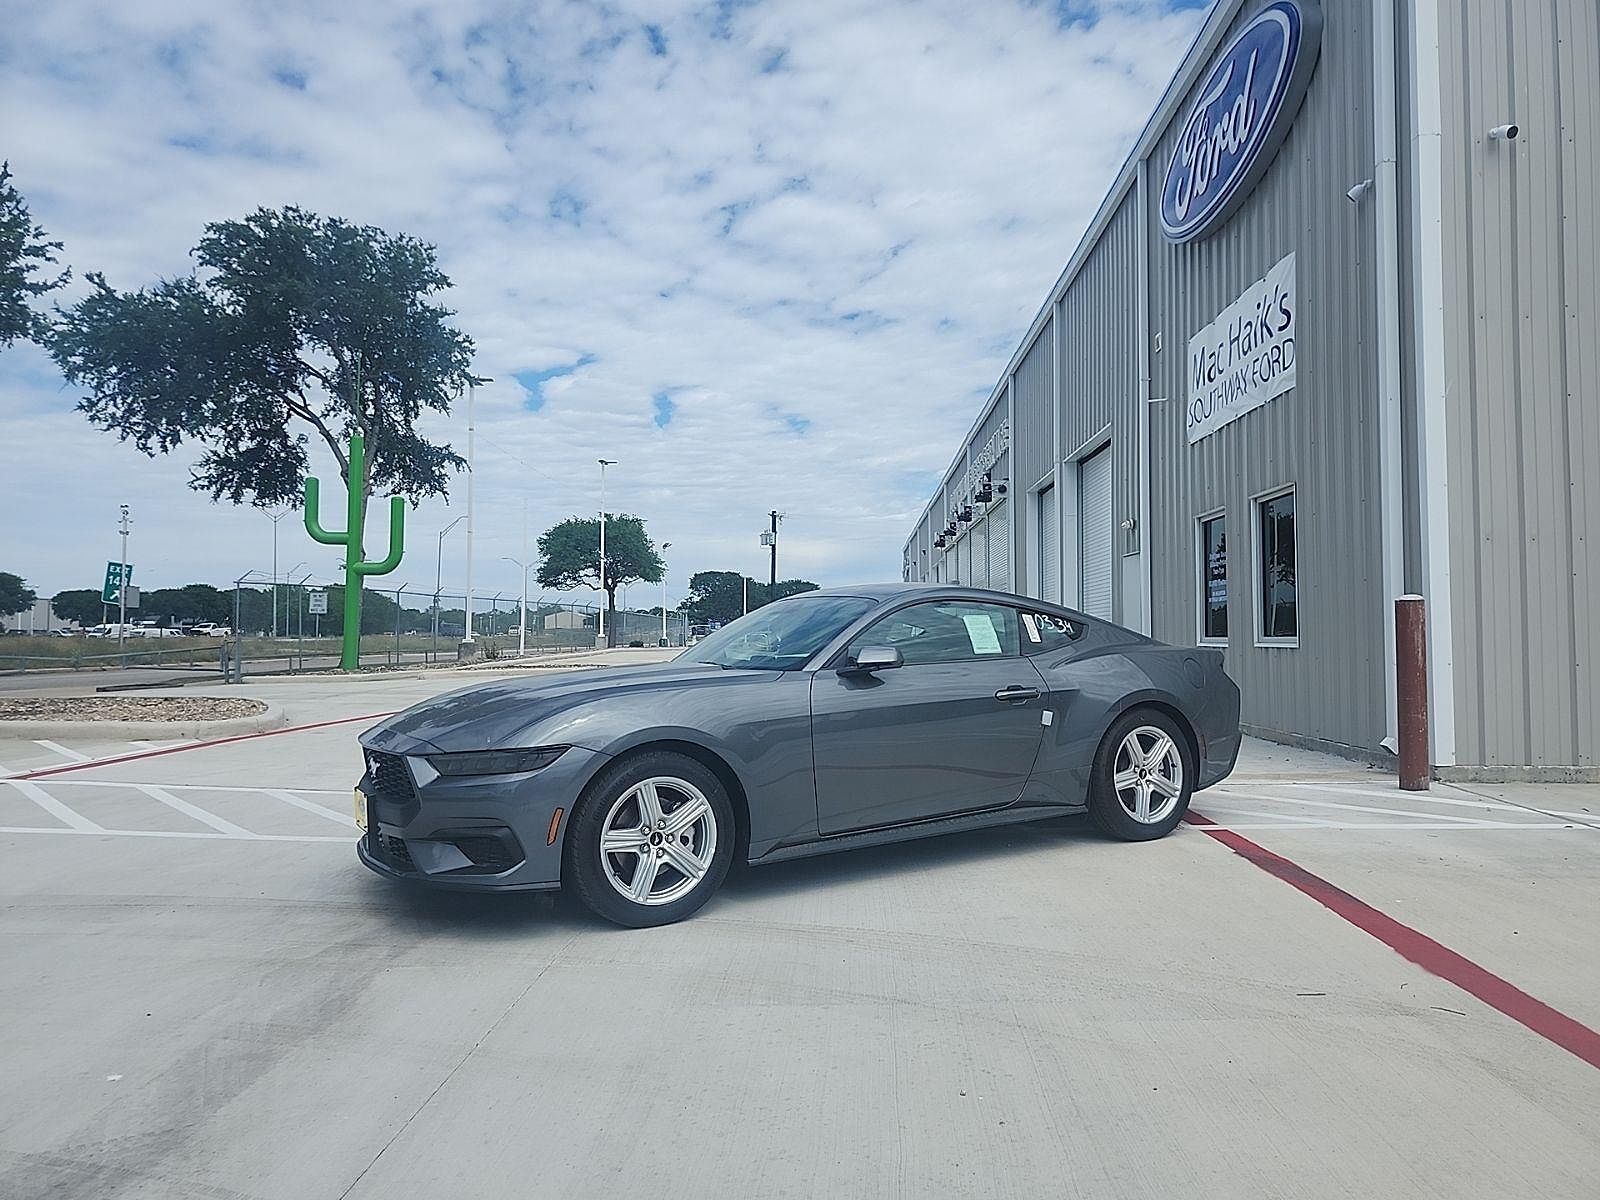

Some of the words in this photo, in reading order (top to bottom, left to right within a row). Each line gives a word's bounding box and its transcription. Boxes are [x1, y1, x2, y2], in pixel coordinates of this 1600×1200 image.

[1174, 47, 1258, 221] Ford
[1187, 363, 1249, 428] SOUTHWAY
[1252, 337, 1295, 388] FORD
[1192, 346, 1225, 394] Mac
[1228, 284, 1292, 367] Haik's
[109, 565, 131, 575] EXT
